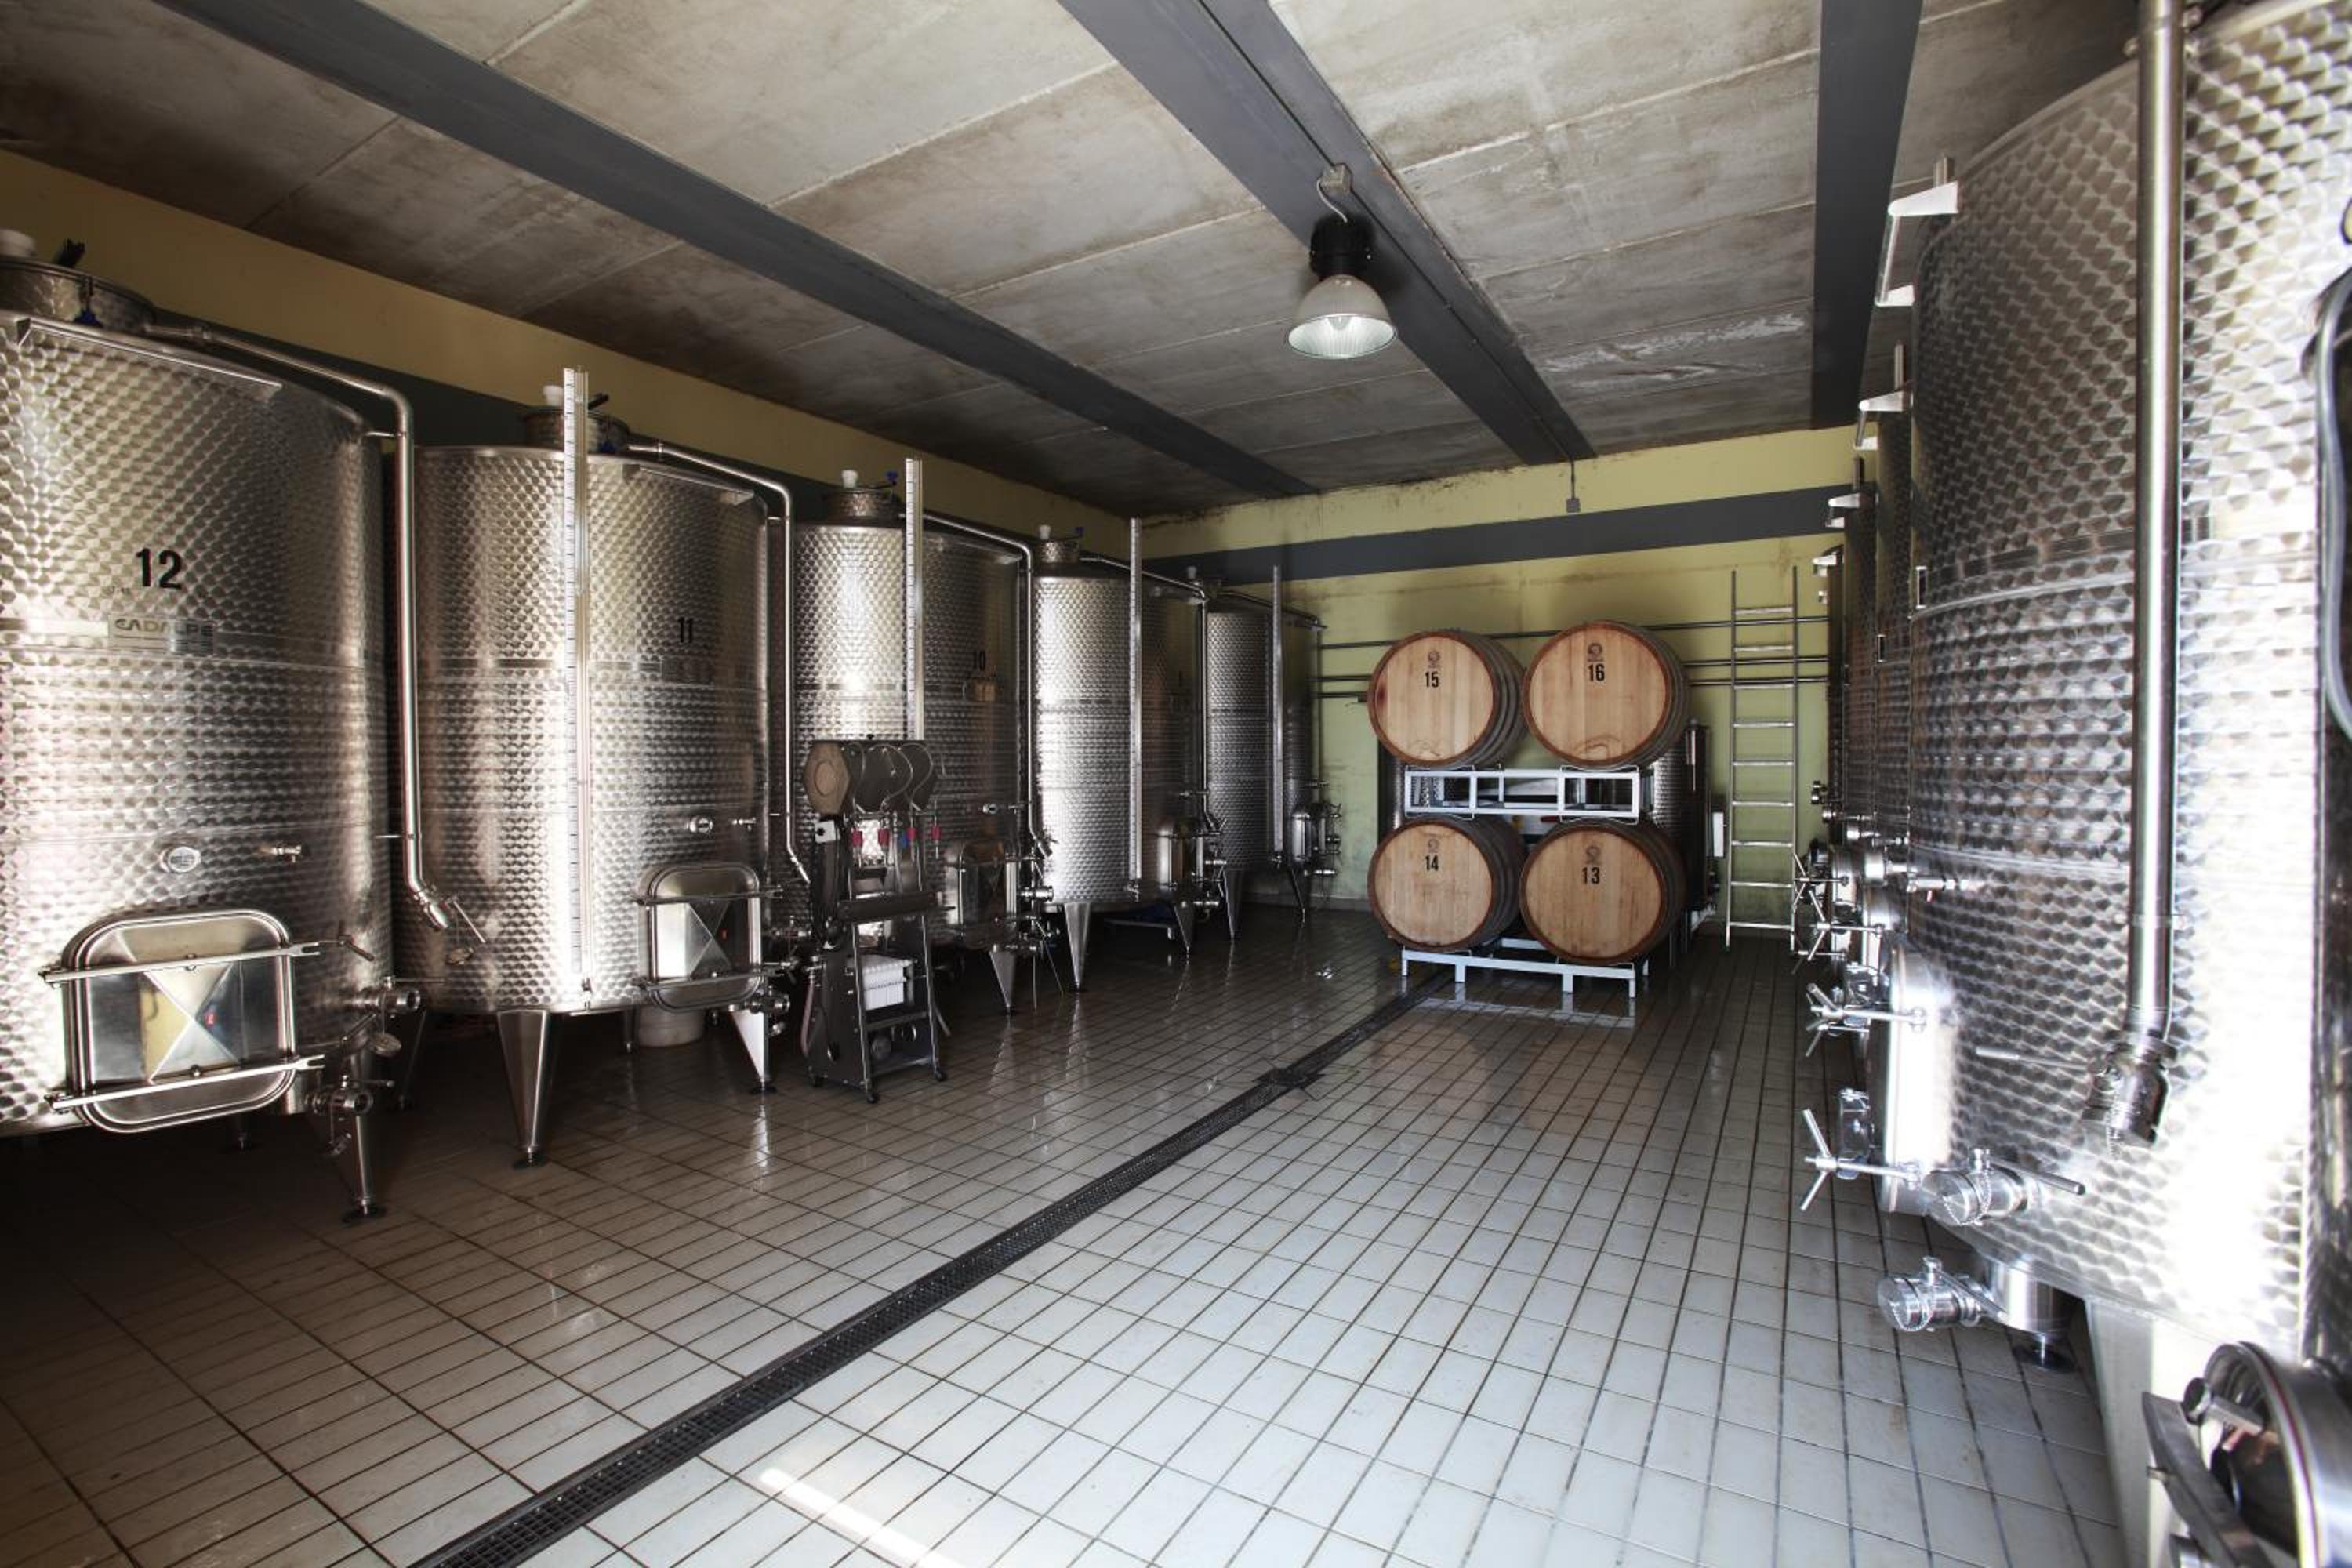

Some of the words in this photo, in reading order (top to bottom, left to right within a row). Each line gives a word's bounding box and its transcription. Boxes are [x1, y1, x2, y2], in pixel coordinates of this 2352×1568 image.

[136, 548, 182, 590] 12
[678, 618, 693, 643] 11
[972, 651, 986, 670] 10
[1425, 671, 1439, 688] 15
[1588, 663, 1605, 681] 16
[1425, 855, 1439, 871] 14
[1581, 866, 1600, 884] 13
